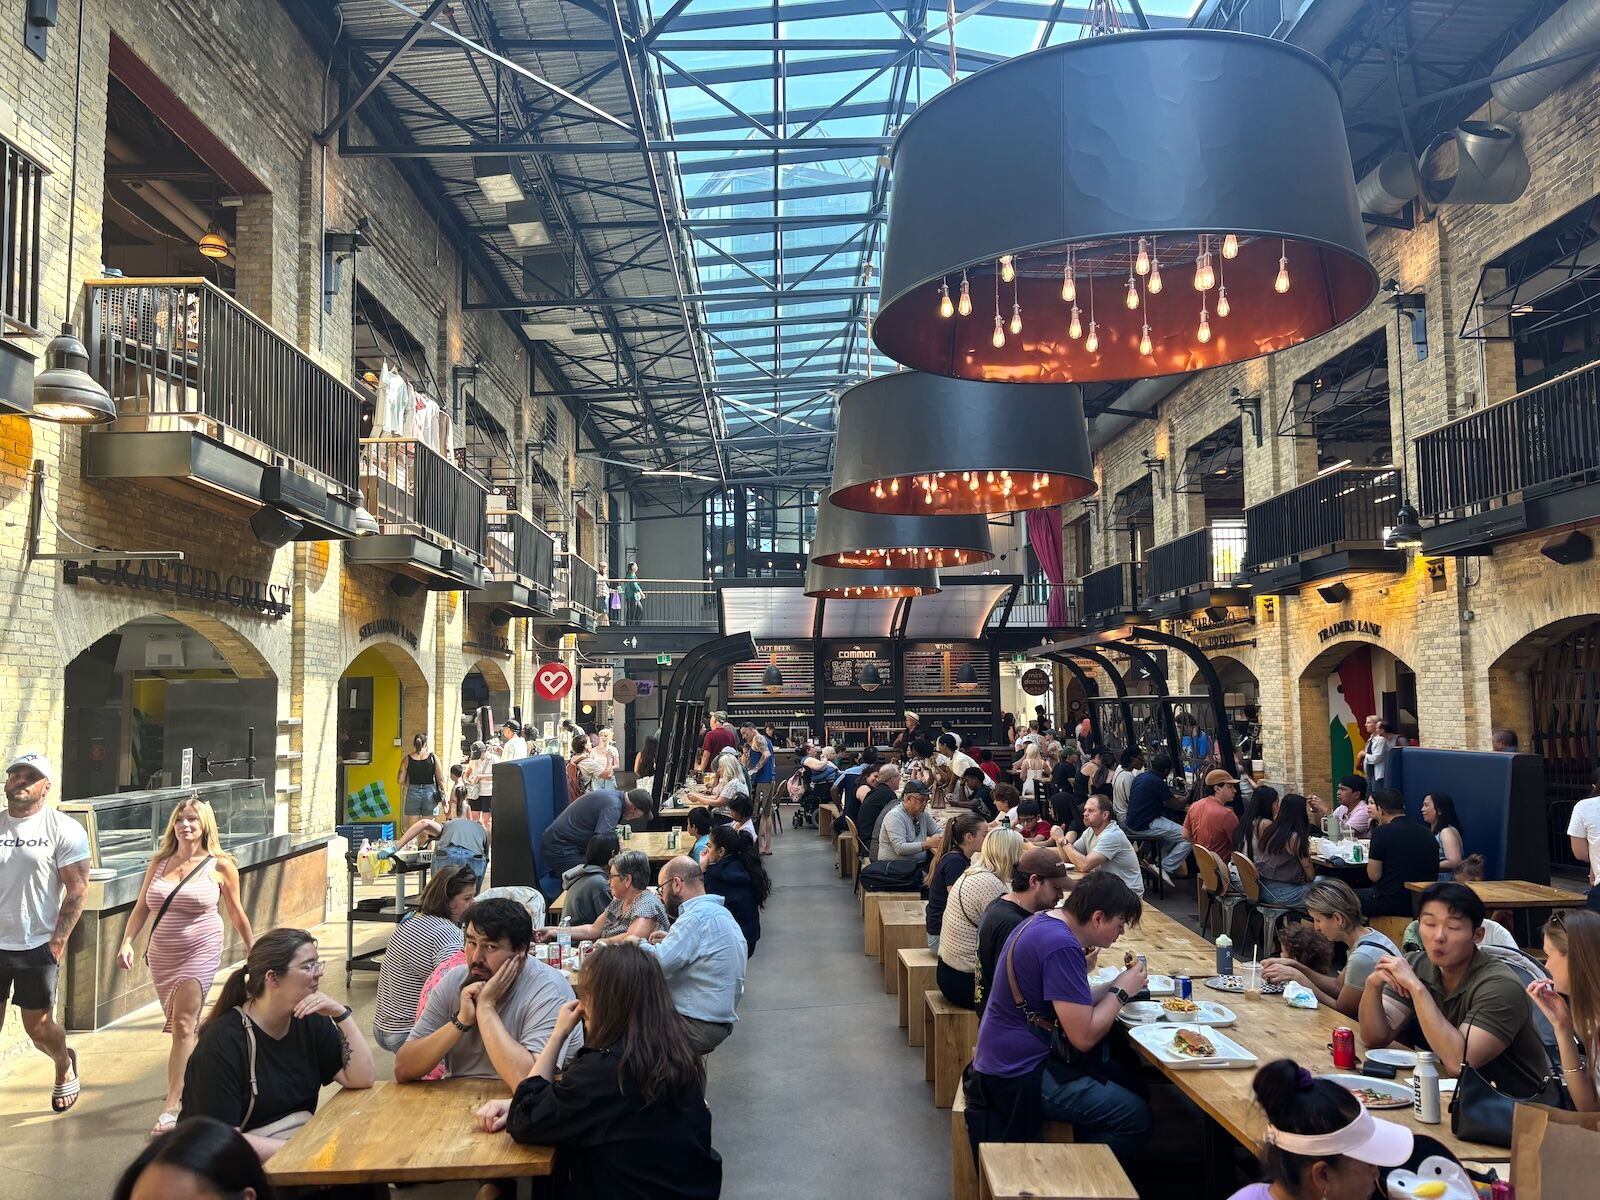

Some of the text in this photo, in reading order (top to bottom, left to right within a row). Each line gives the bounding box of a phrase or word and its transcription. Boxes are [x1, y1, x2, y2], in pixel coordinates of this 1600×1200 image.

[91, 545, 291, 617] CRAFTED CRUST
[1318, 620, 1382, 643] TRADERS LANE
[1413, 1074, 1422, 1113] EARTH
